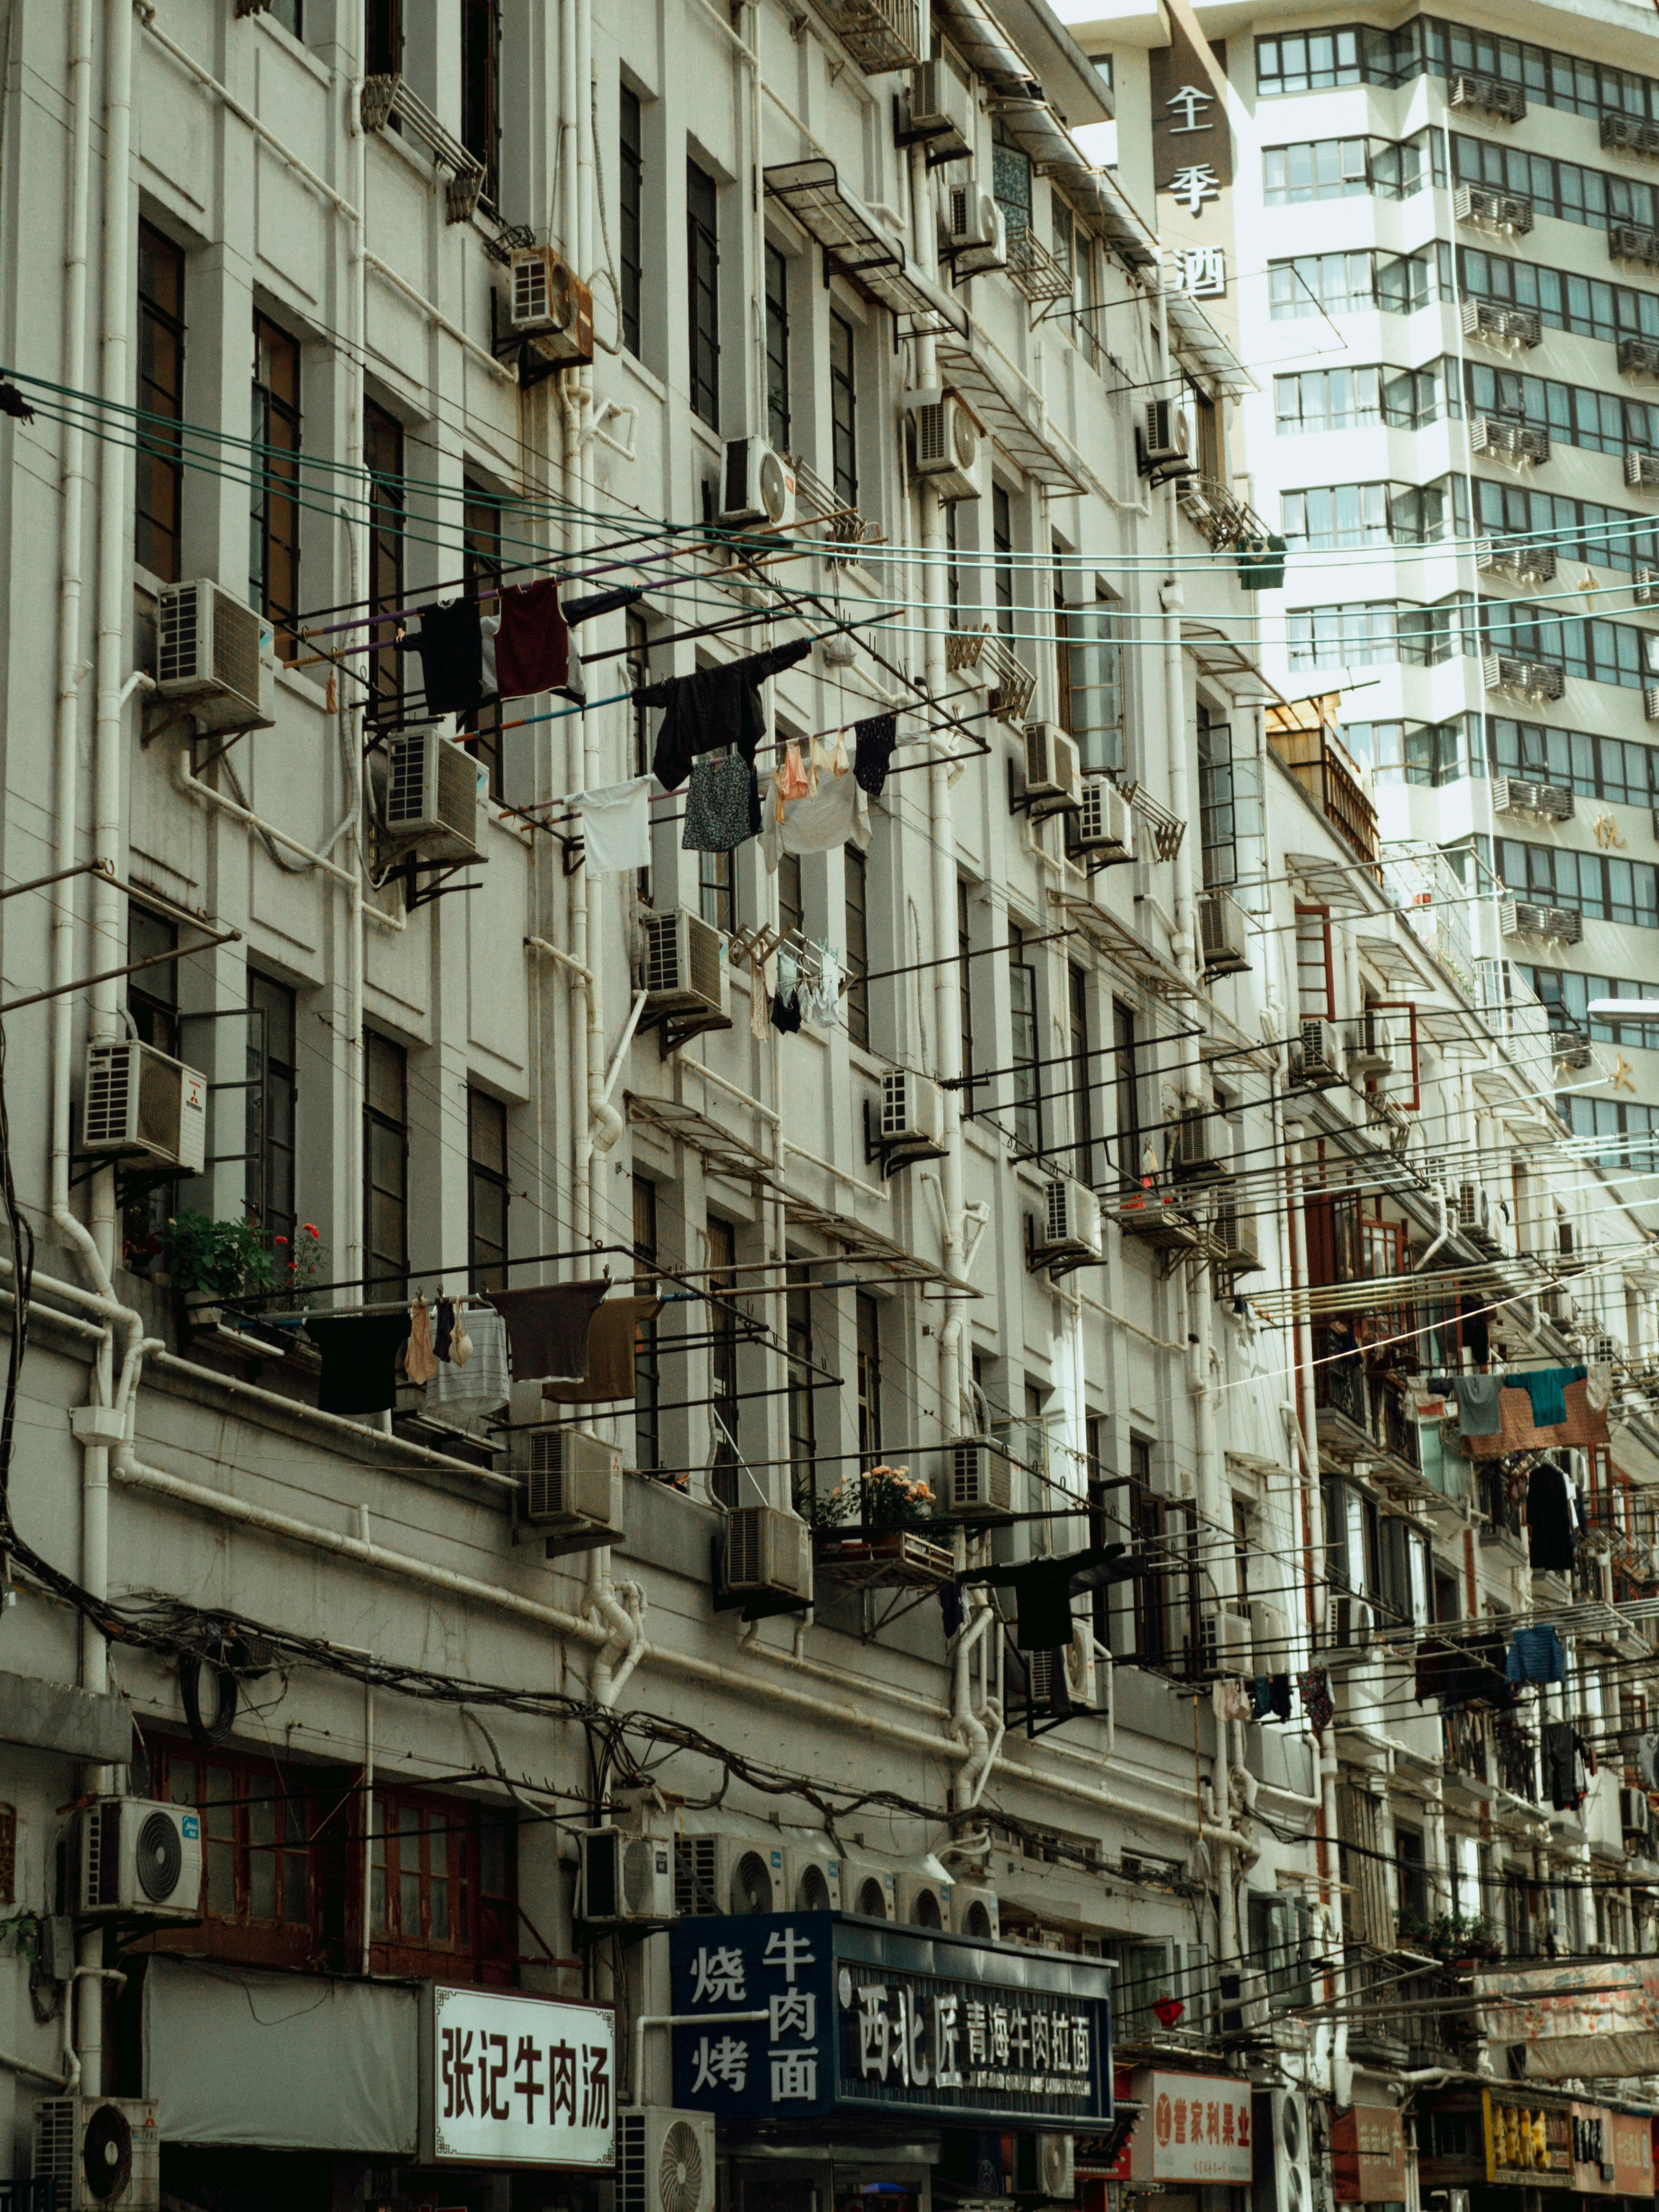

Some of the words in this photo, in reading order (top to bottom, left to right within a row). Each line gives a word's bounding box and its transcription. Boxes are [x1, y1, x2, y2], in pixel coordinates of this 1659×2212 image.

[1166, 85, 1225, 296] 全季酒
[441, 2027, 610, 2129] 张记牛肉汤
[689, 1946, 750, 2094] 烧烤
[762, 1927, 819, 2103] 牛肉面
[857, 1984, 964, 2089] 西北匠
[966, 2000, 1090, 2072] 青海牛肉拉面
